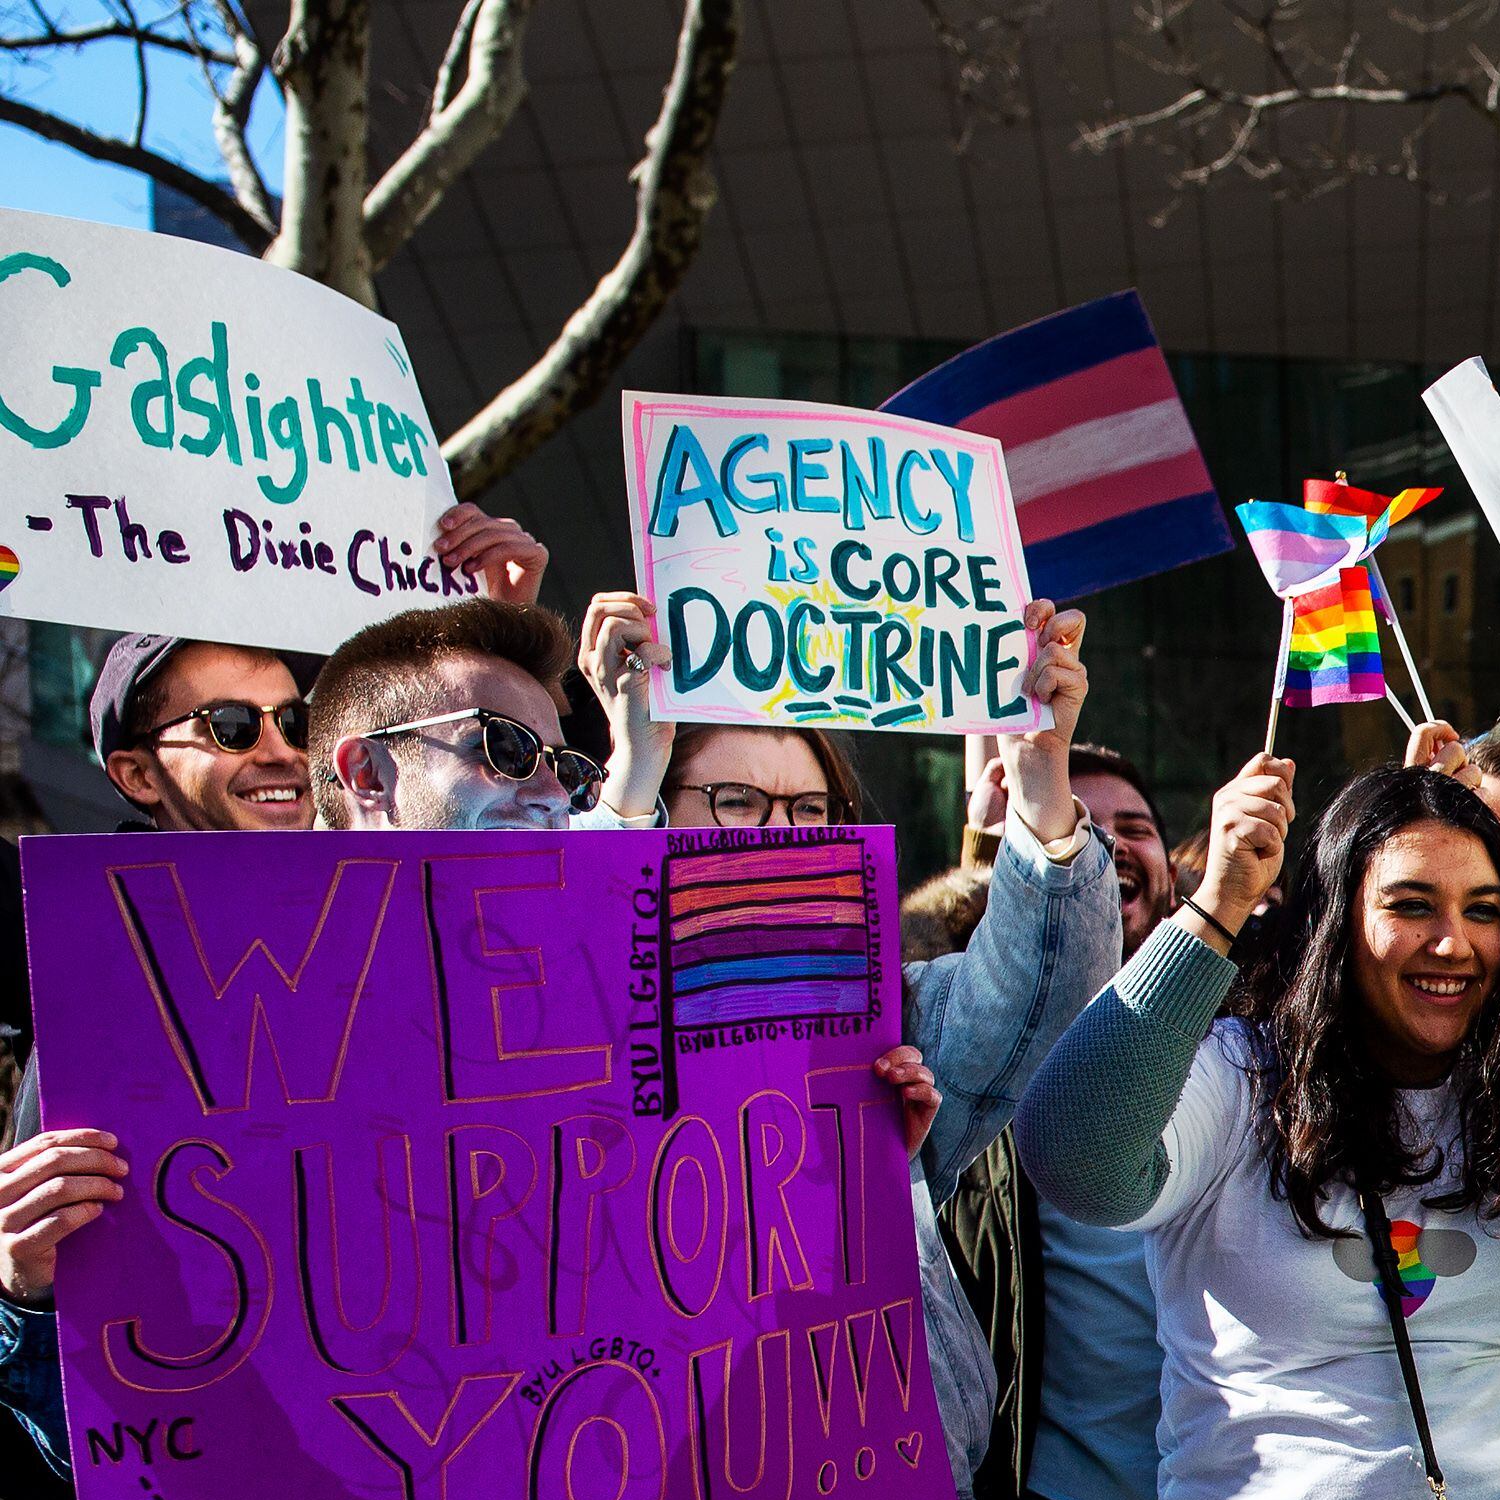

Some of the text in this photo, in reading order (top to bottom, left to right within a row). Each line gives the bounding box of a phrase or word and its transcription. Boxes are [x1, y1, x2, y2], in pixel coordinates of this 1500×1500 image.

[0, 252, 429, 504] Gaslighter
[648, 424, 975, 543] AGENCY
[222, 508, 338, 572] Dixie
[346, 529, 480, 597] Chicks
[765, 527, 1008, 613] is CORE
[668, 586, 1028, 720] DOCTRINE
[105, 849, 613, 1115] WE
[629, 862, 662, 1117] BYU LGBTQ+
[103, 1066, 897, 1391] SUPPORT
[85, 1416, 202, 1467] NYC
[520, 1359, 565, 1406] BYU
